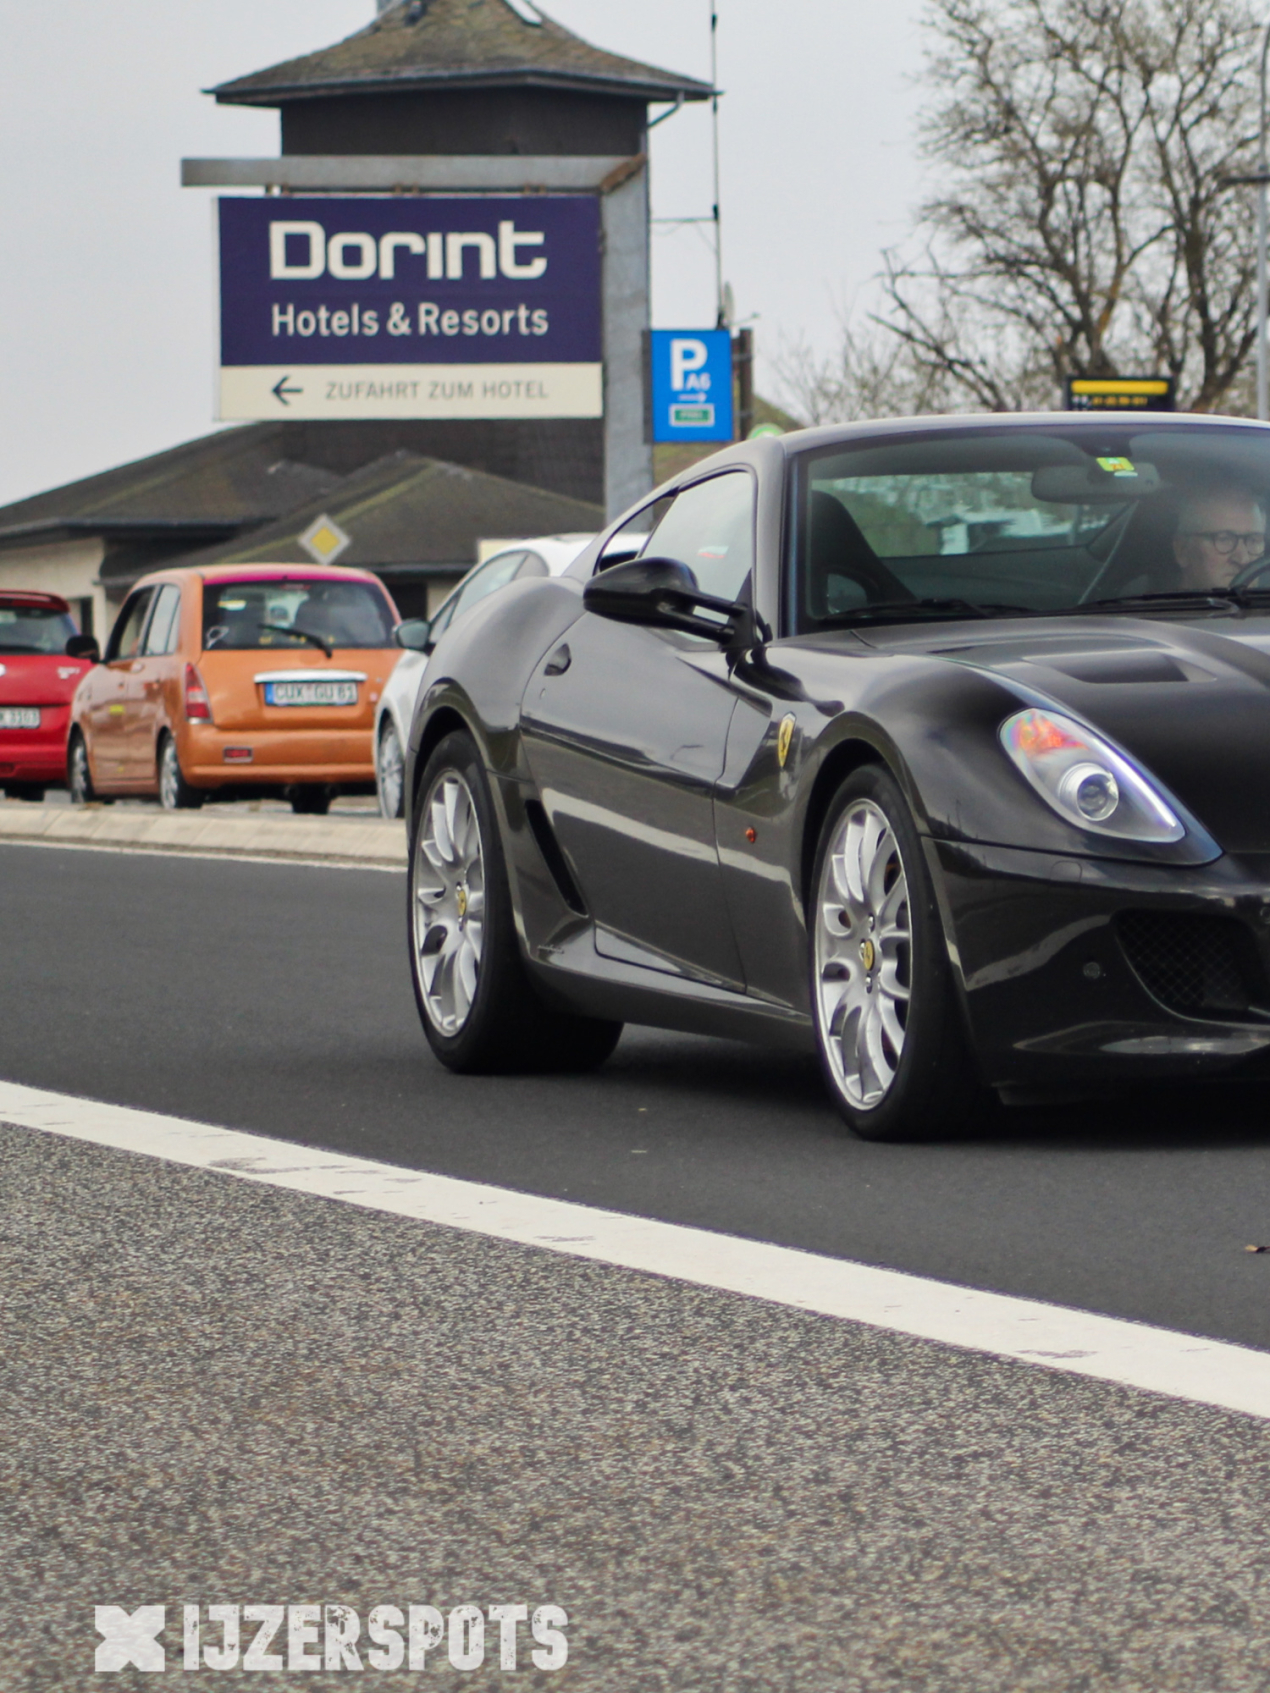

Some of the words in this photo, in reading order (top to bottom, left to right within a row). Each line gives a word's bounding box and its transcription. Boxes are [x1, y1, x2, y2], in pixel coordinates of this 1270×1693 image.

[269, 220, 548, 280] Dorint
[272, 303, 380, 336] Hotels
[387, 302, 411, 335] &
[419, 303, 549, 335] Resorts
[670, 338, 708, 391] P
[325, 381, 420, 400] ZUFAHRT
[428, 381, 474, 399] ZUM
[482, 380, 549, 399] HOTEL
[275, 686, 304, 699] CUX
